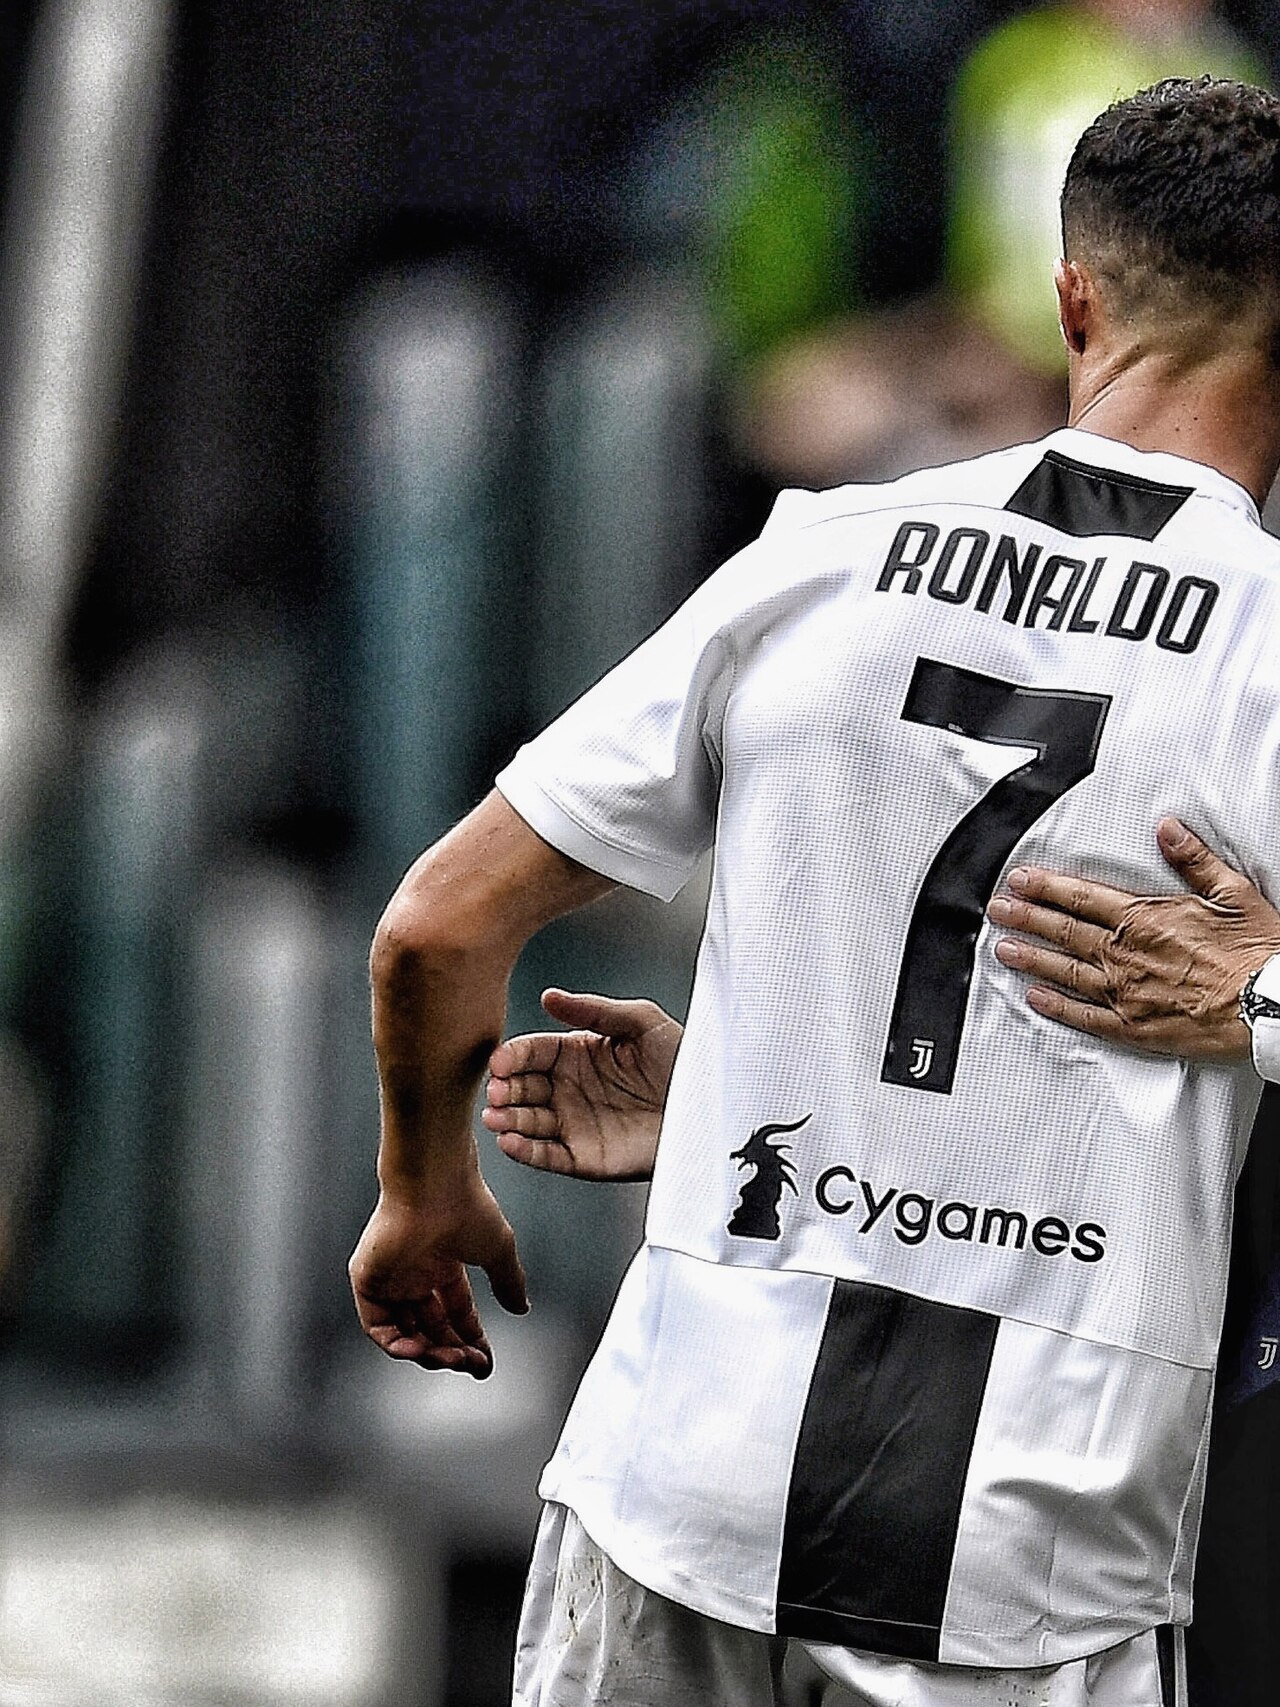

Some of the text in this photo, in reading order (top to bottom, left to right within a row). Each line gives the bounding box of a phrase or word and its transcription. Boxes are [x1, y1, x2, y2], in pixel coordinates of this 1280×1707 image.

[875, 521, 1220, 654] RONALDO
[880, 656, 1113, 1096] 7
[815, 1166, 1107, 1263] Cygames
